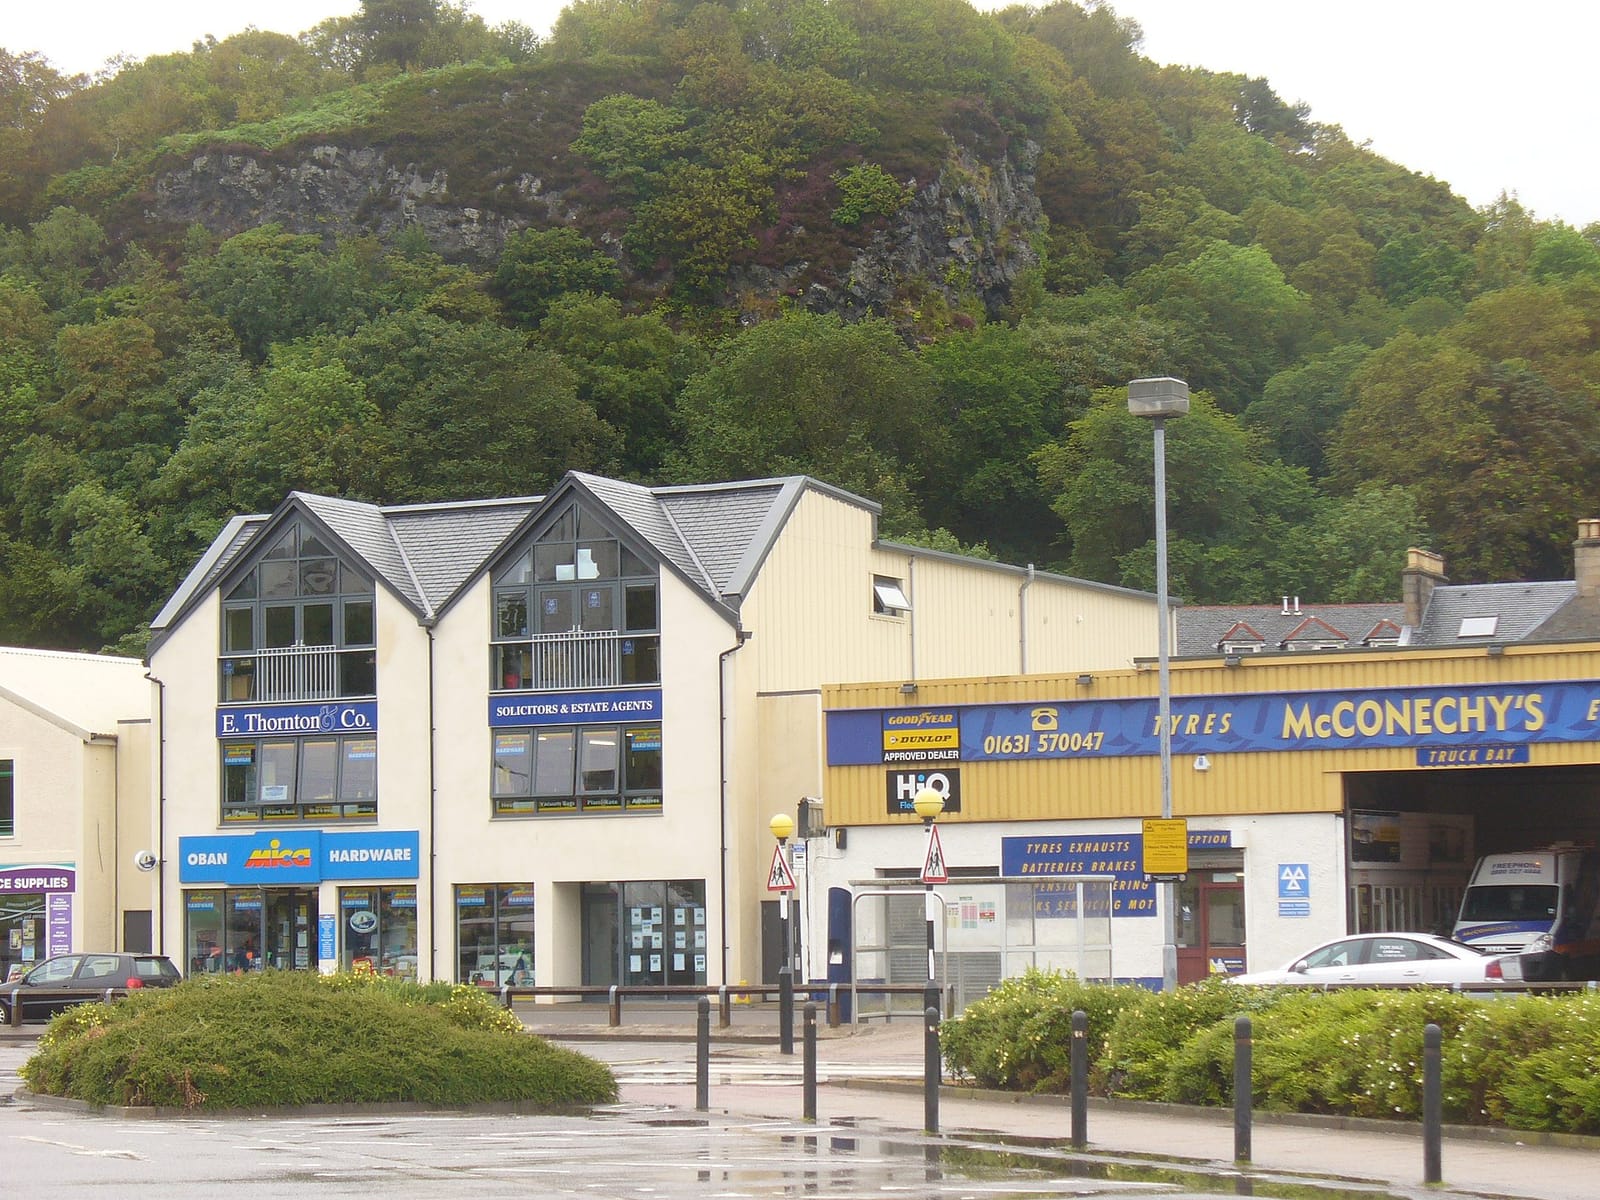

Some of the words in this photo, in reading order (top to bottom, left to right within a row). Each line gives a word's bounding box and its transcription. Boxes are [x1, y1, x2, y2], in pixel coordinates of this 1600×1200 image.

[496, 704, 559, 716] SOLICITORS
[560, 704, 569, 713] &
[571, 702, 609, 713] ESTATE
[612, 700, 653, 711] AGENTS
[222, 715, 239, 732] E.
[244, 713, 320, 732] Thornton
[341, 709, 370, 728] Co.
[888, 711, 953, 726] GOODYEAR
[1282, 693, 1545, 739] McCONECHY'S
[1153, 713, 1232, 736] TYRES
[900, 734, 952, 744] DUNLOP
[984, 734, 1030, 754] 01631
[1037, 732, 1105, 752] 570047
[884, 751, 927, 761] APPROVED
[928, 750, 959, 760] DEALER
[1429, 749, 1479, 763] TRUCK
[1485, 748, 1516, 761] BAY
[1027, 843, 1063, 854] TYRES
[1069, 841, 1130, 853] EXHAUSTS
[188, 853, 228, 866] OBAN
[329, 848, 411, 862] HARDWARE
[1021, 861, 1084, 873] BATTERIES
[1091, 860, 1137, 871] BRAKES
[14, 877, 69, 889] SUPPLIES
[1128, 900, 1154, 910] MOT
